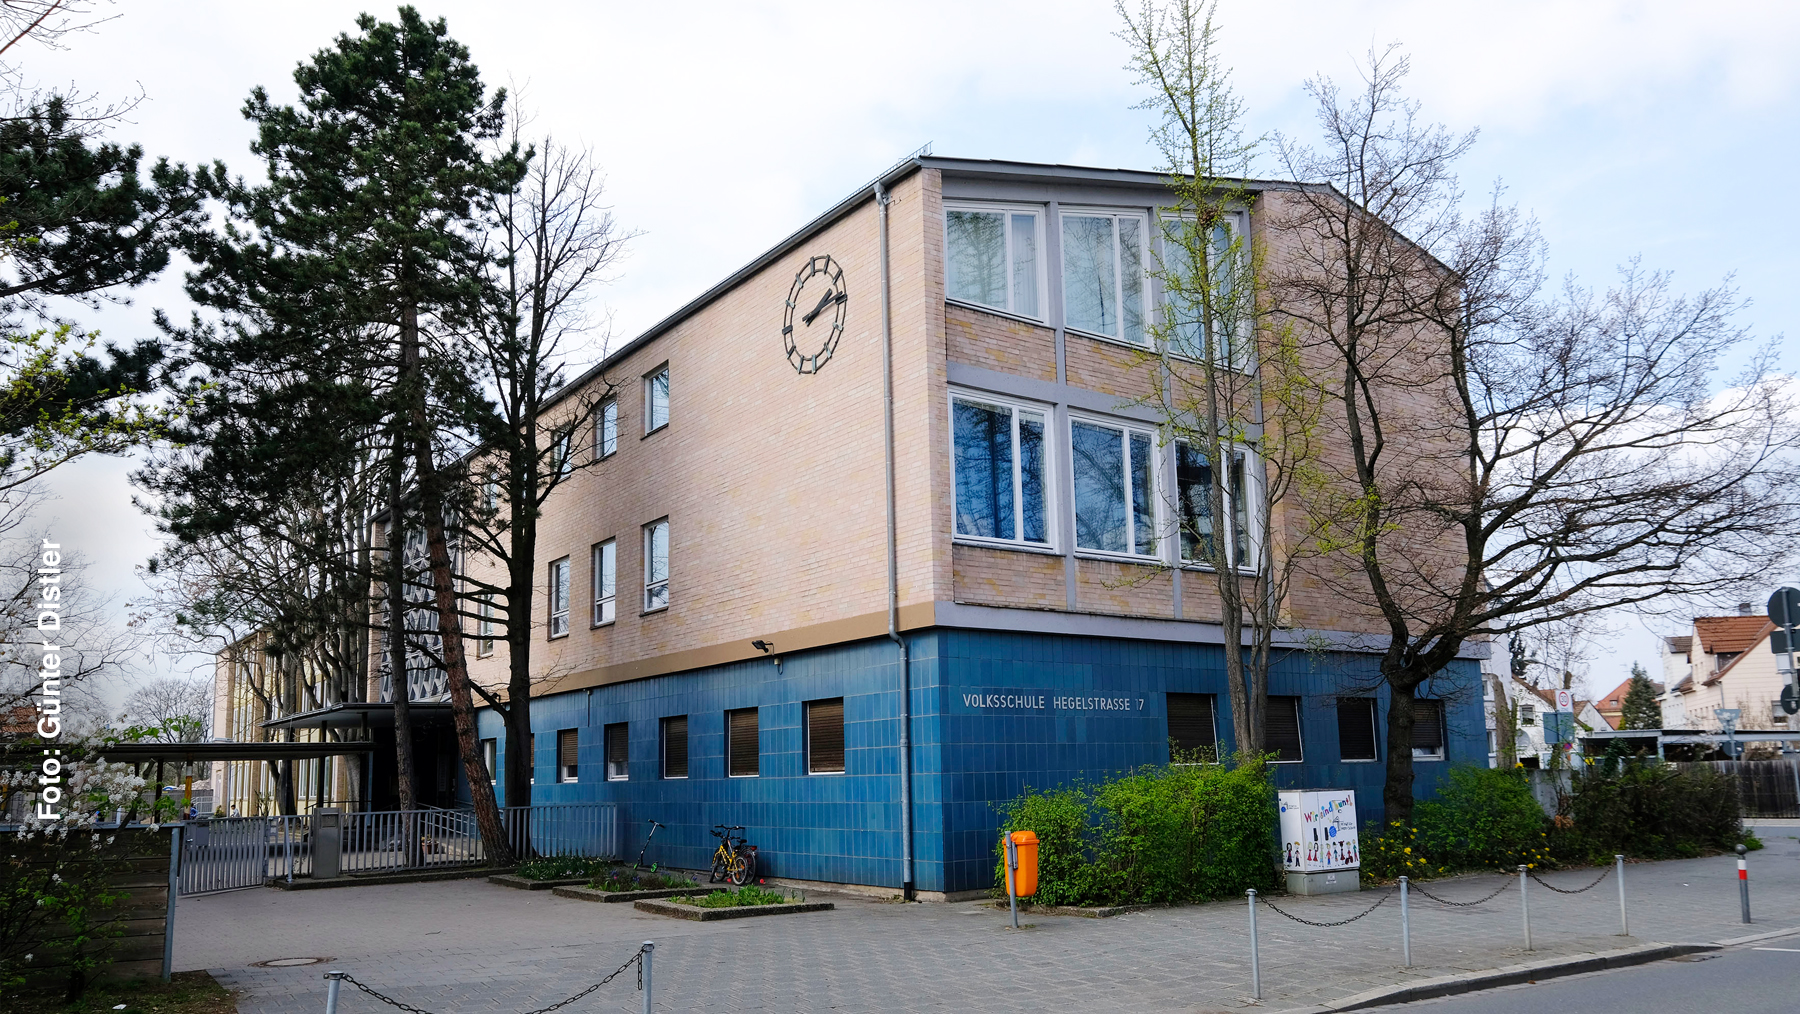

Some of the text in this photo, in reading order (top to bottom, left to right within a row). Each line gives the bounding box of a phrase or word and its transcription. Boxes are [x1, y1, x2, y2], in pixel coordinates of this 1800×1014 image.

[962, 693, 1045, 709] VOLKSSCHULE
[1053, 696, 1131, 711] HEGELSTRASSE
[1304, 811, 1319, 823] Wir
[1320, 801, 1334, 819] sind
